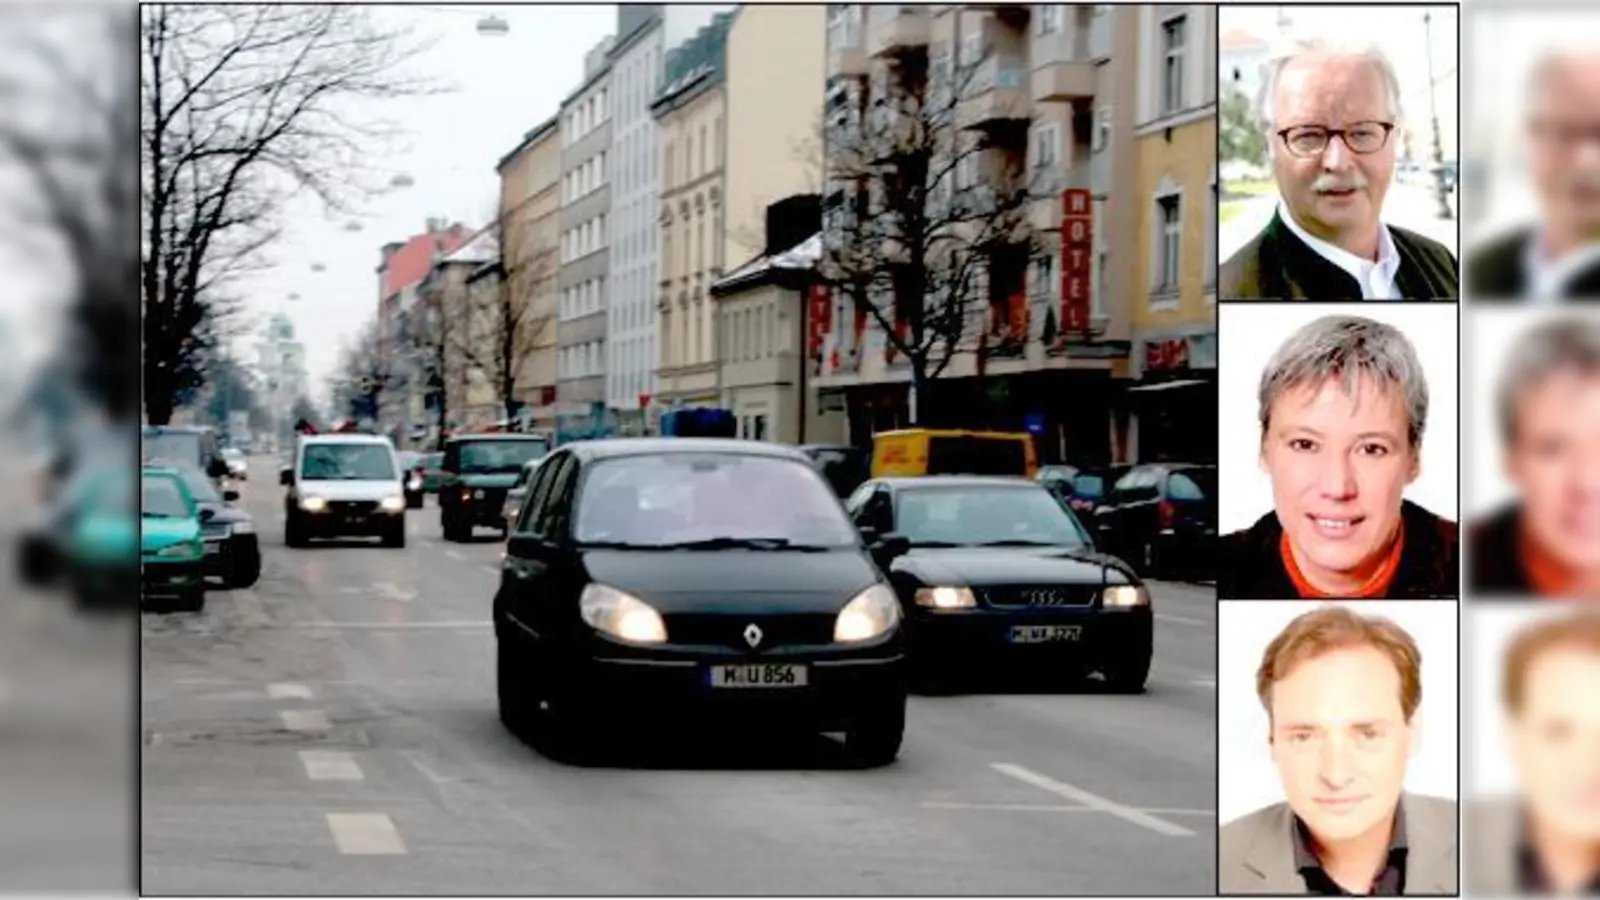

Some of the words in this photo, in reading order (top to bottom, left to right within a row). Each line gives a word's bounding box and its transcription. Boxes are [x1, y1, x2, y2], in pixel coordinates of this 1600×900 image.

[1070, 192, 1085, 327] HOTEL
[724, 666, 736, 684] M
[748, 666, 759, 684] U
[764, 665, 795, 684] 856
